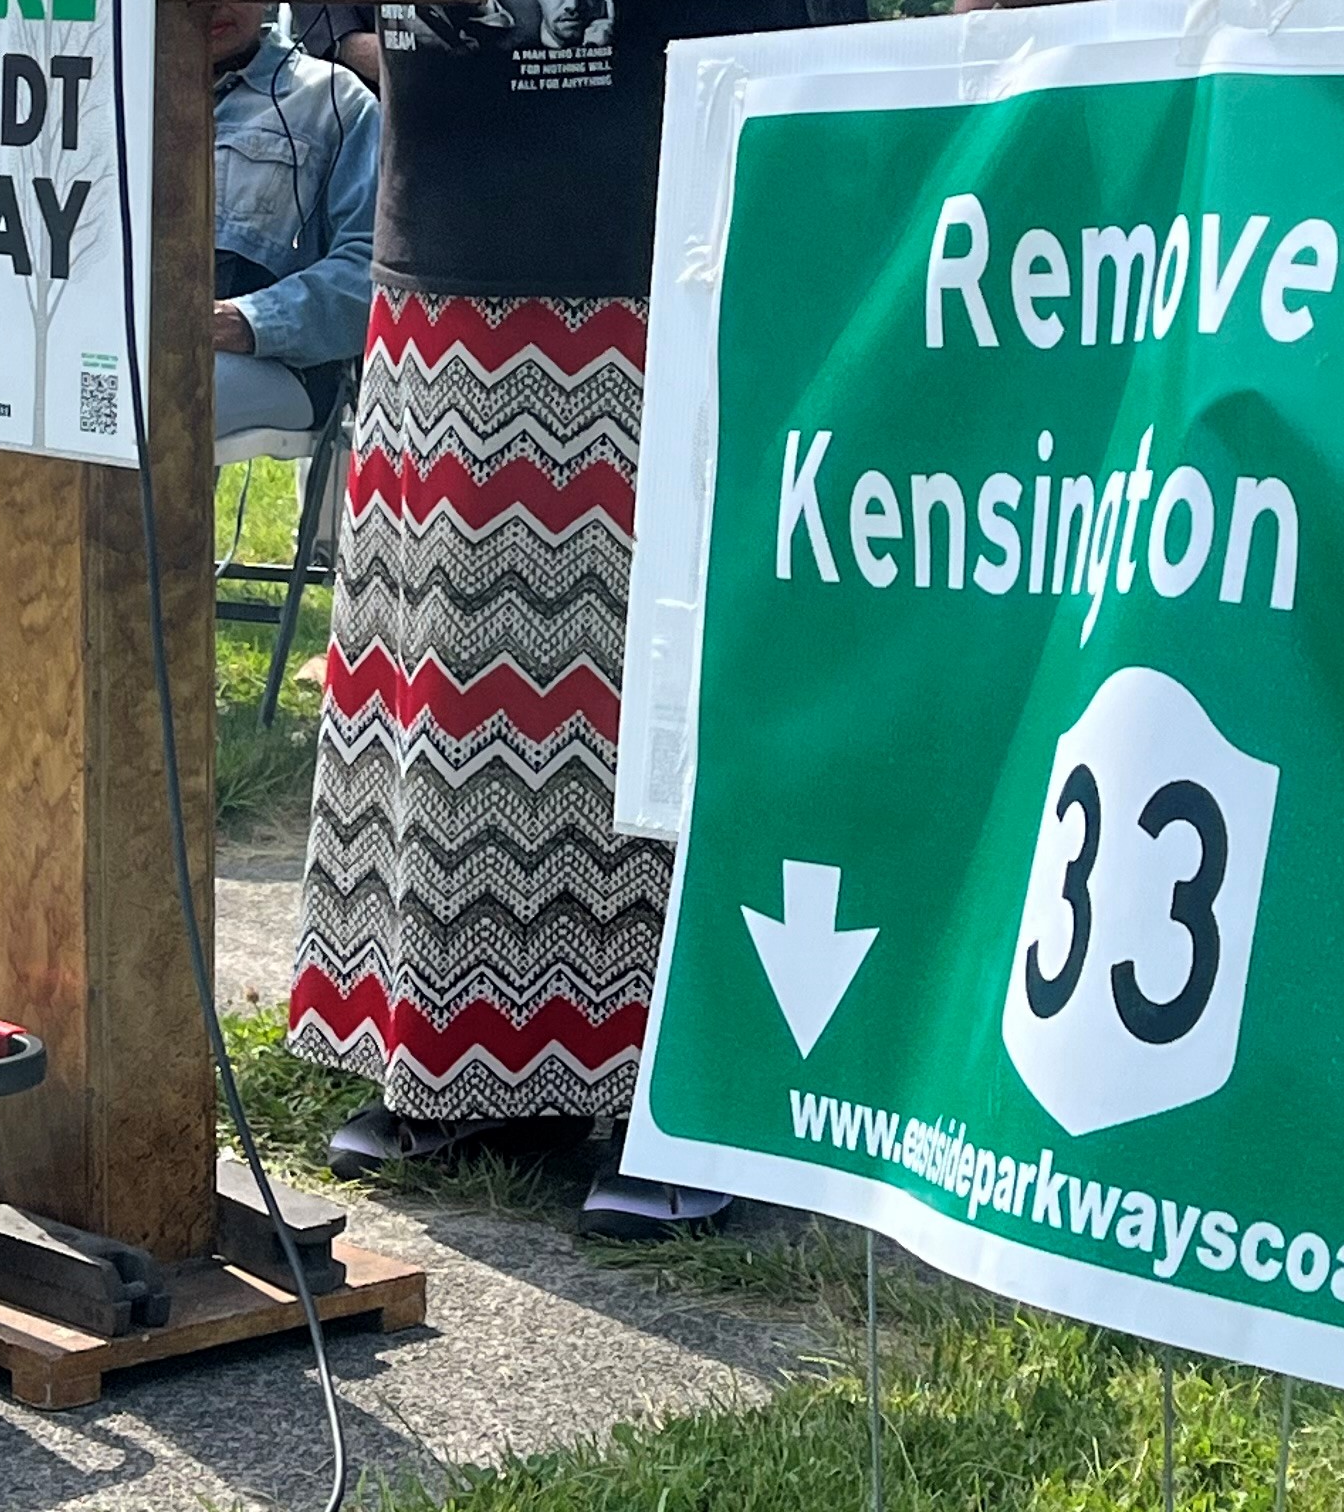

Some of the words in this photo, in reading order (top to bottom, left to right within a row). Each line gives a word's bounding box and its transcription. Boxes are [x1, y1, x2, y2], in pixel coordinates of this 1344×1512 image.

[925, 192, 1339, 349] Remove
[775, 423, 1299, 648] Kensington
[1025, 764, 1228, 1045] 33
